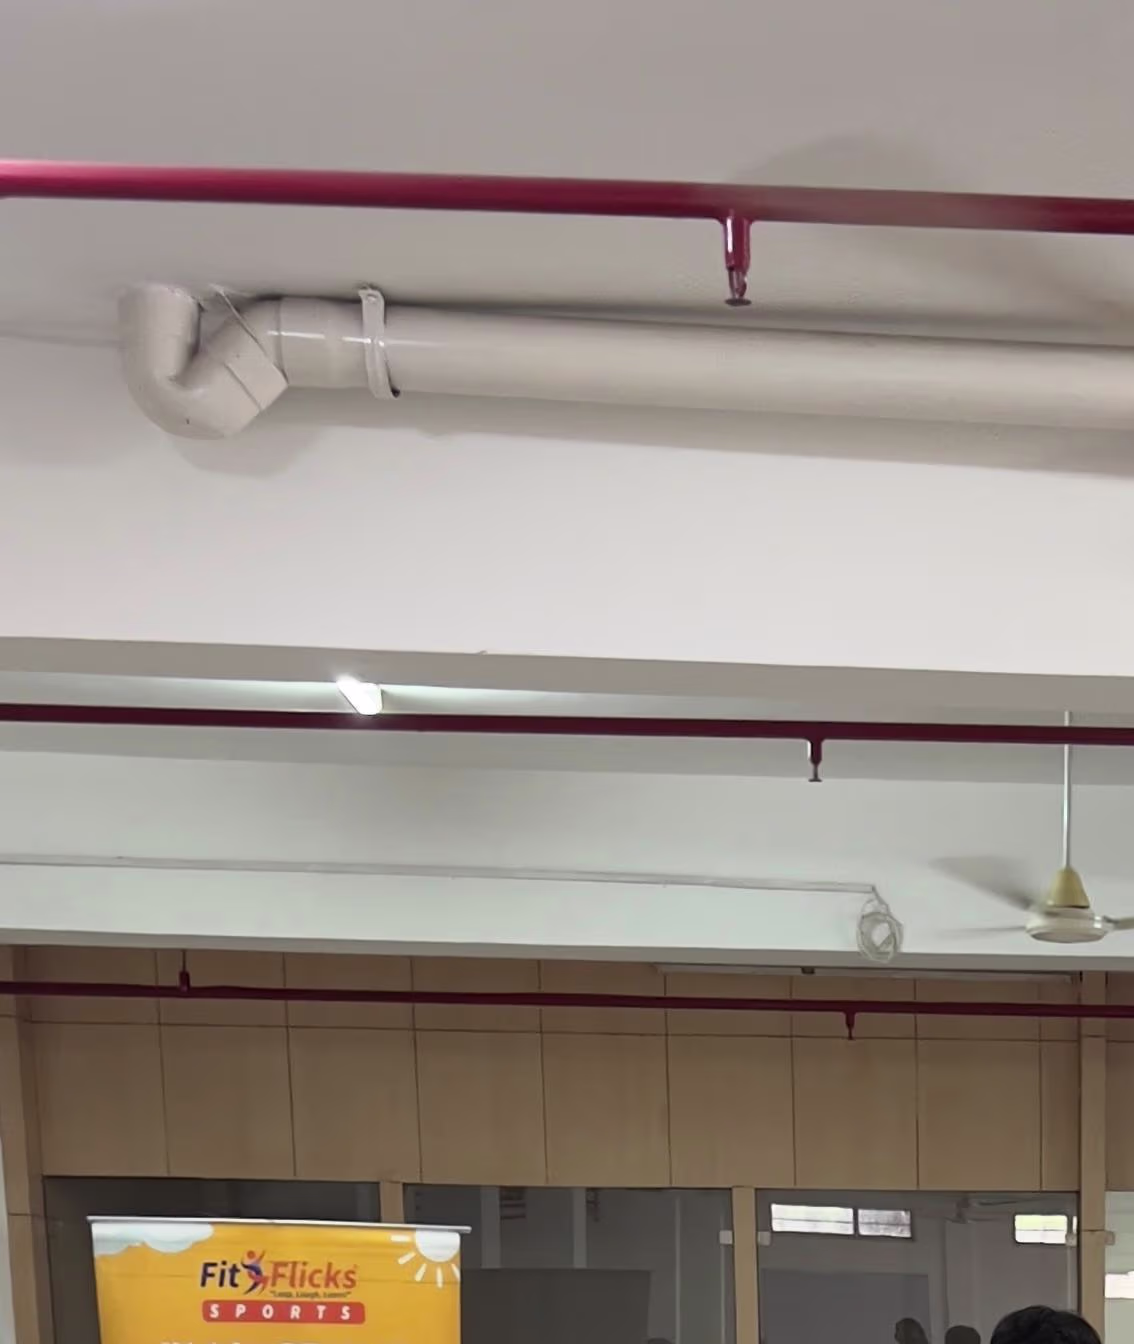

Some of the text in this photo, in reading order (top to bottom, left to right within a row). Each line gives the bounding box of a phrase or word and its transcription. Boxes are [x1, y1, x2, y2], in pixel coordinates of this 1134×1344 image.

[200, 1260, 357, 1289] Fit Flicks
[209, 1303, 351, 1320] SPORTS
